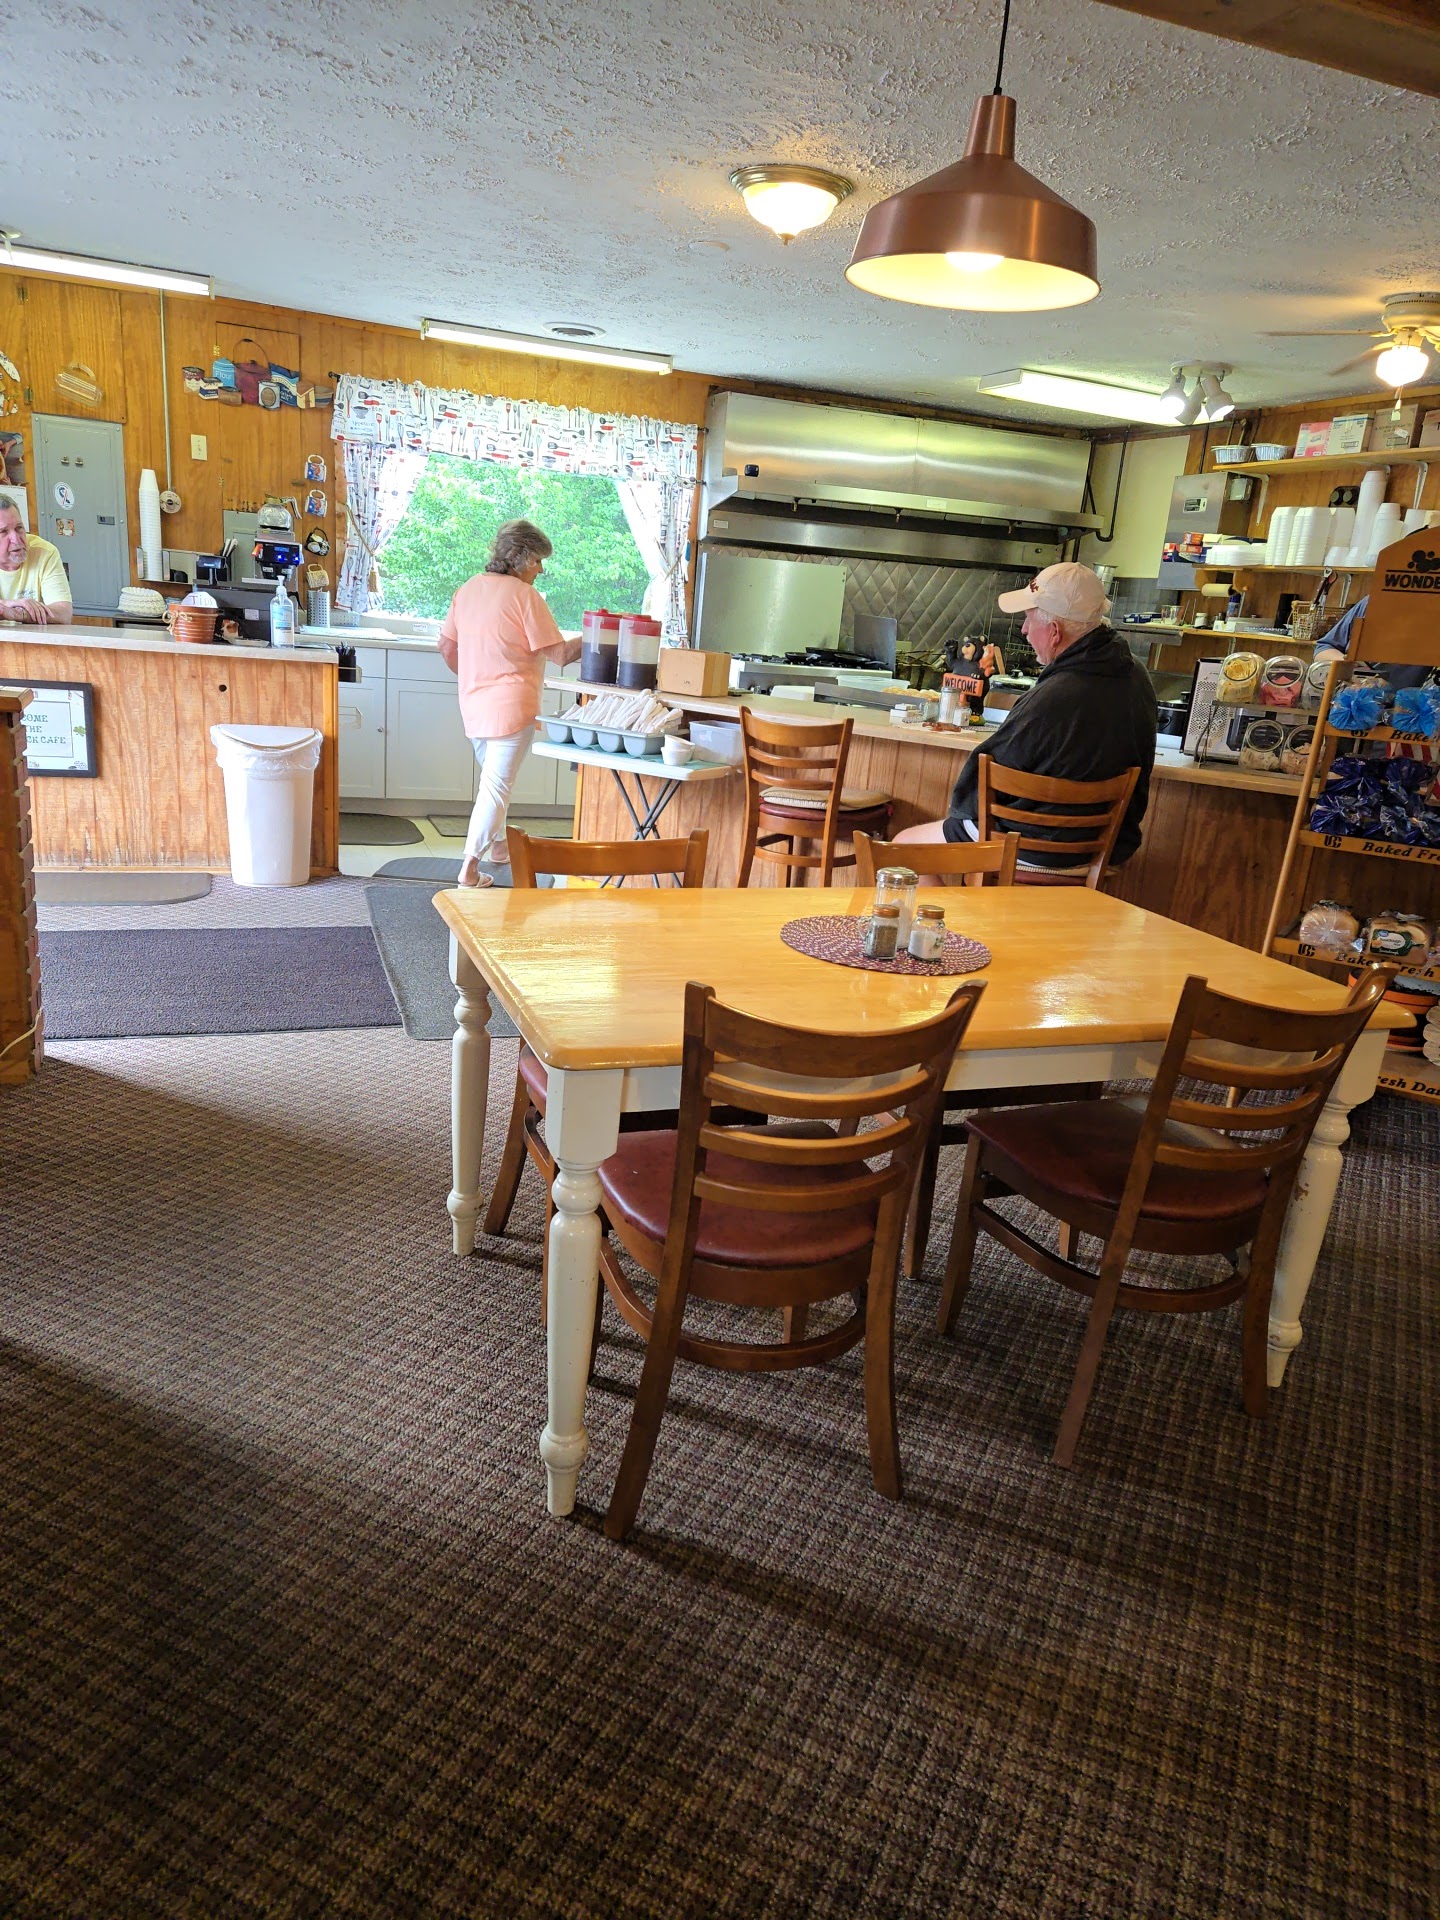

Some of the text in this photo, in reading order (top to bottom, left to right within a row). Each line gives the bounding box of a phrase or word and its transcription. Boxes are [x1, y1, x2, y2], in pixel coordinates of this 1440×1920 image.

[215, 370, 234, 380] Flour
[188, 595, 213, 607] Tips
[944, 676, 978, 694] WELCOME
[40, 736, 66, 744] CAFE
[1362, 841, 1412, 857] Baked
